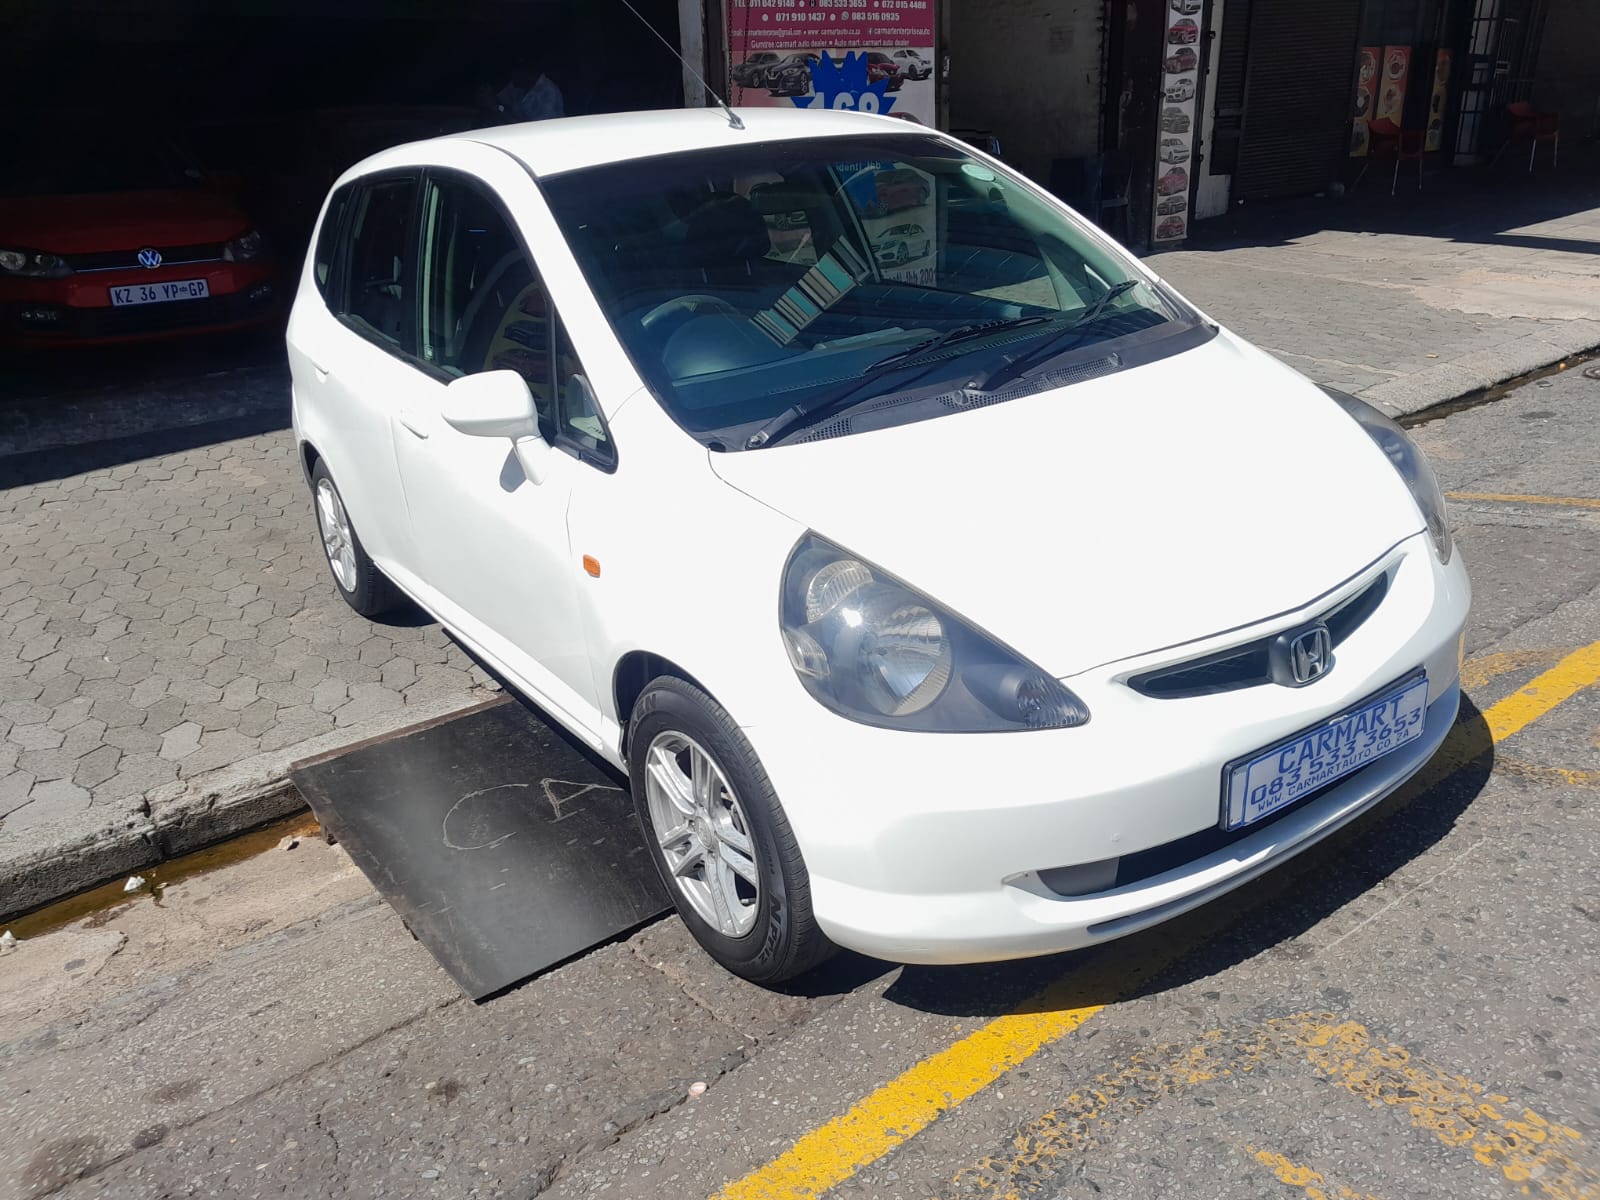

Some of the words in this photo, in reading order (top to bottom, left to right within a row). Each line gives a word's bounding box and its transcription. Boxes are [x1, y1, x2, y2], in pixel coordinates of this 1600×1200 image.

[775, 12, 790, 21] 071
[791, 12, 806, 21] 910
[808, 12, 826, 21] 1437
[851, 12, 866, 21] 083
[114, 287, 133, 304] KZ
[140, 286, 157, 301] 36
[163, 284, 179, 298] YP
[188, 282, 205, 297] GP
[1250, 766, 1302, 806] 083
[1308, 739, 1357, 776] 533
[1364, 707, 1421, 749] 3653
[1278, 694, 1405, 774] CARMART
